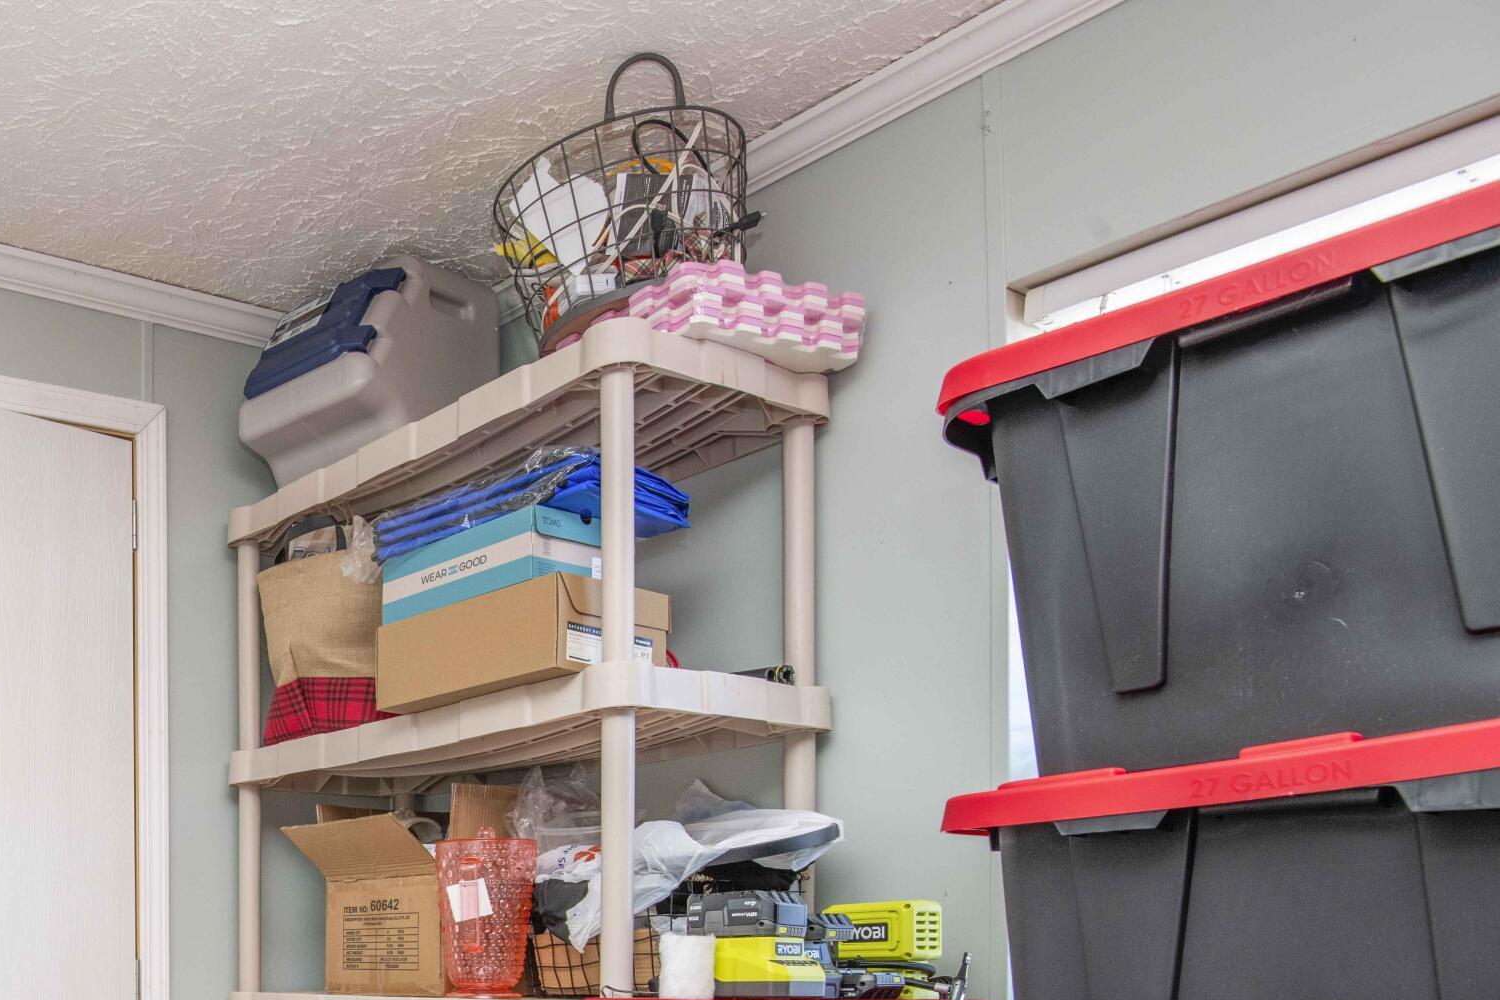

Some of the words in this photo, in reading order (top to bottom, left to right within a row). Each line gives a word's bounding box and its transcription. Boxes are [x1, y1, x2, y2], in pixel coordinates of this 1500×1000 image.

[1178, 294, 1209, 321] 27
[1218, 250, 1336, 305] GALLON
[541, 515, 562, 528] TOMS
[421, 568, 448, 585] WEAR
[458, 554, 488, 572] GOOD
[1188, 776, 1221, 799] 27
[1230, 760, 1353, 794] GALLON
[370, 898, 400, 912] 60642
[852, 926, 886, 940] YOBI
[776, 943, 801, 955] RYOBI
[804, 948, 820, 959] YOBI
